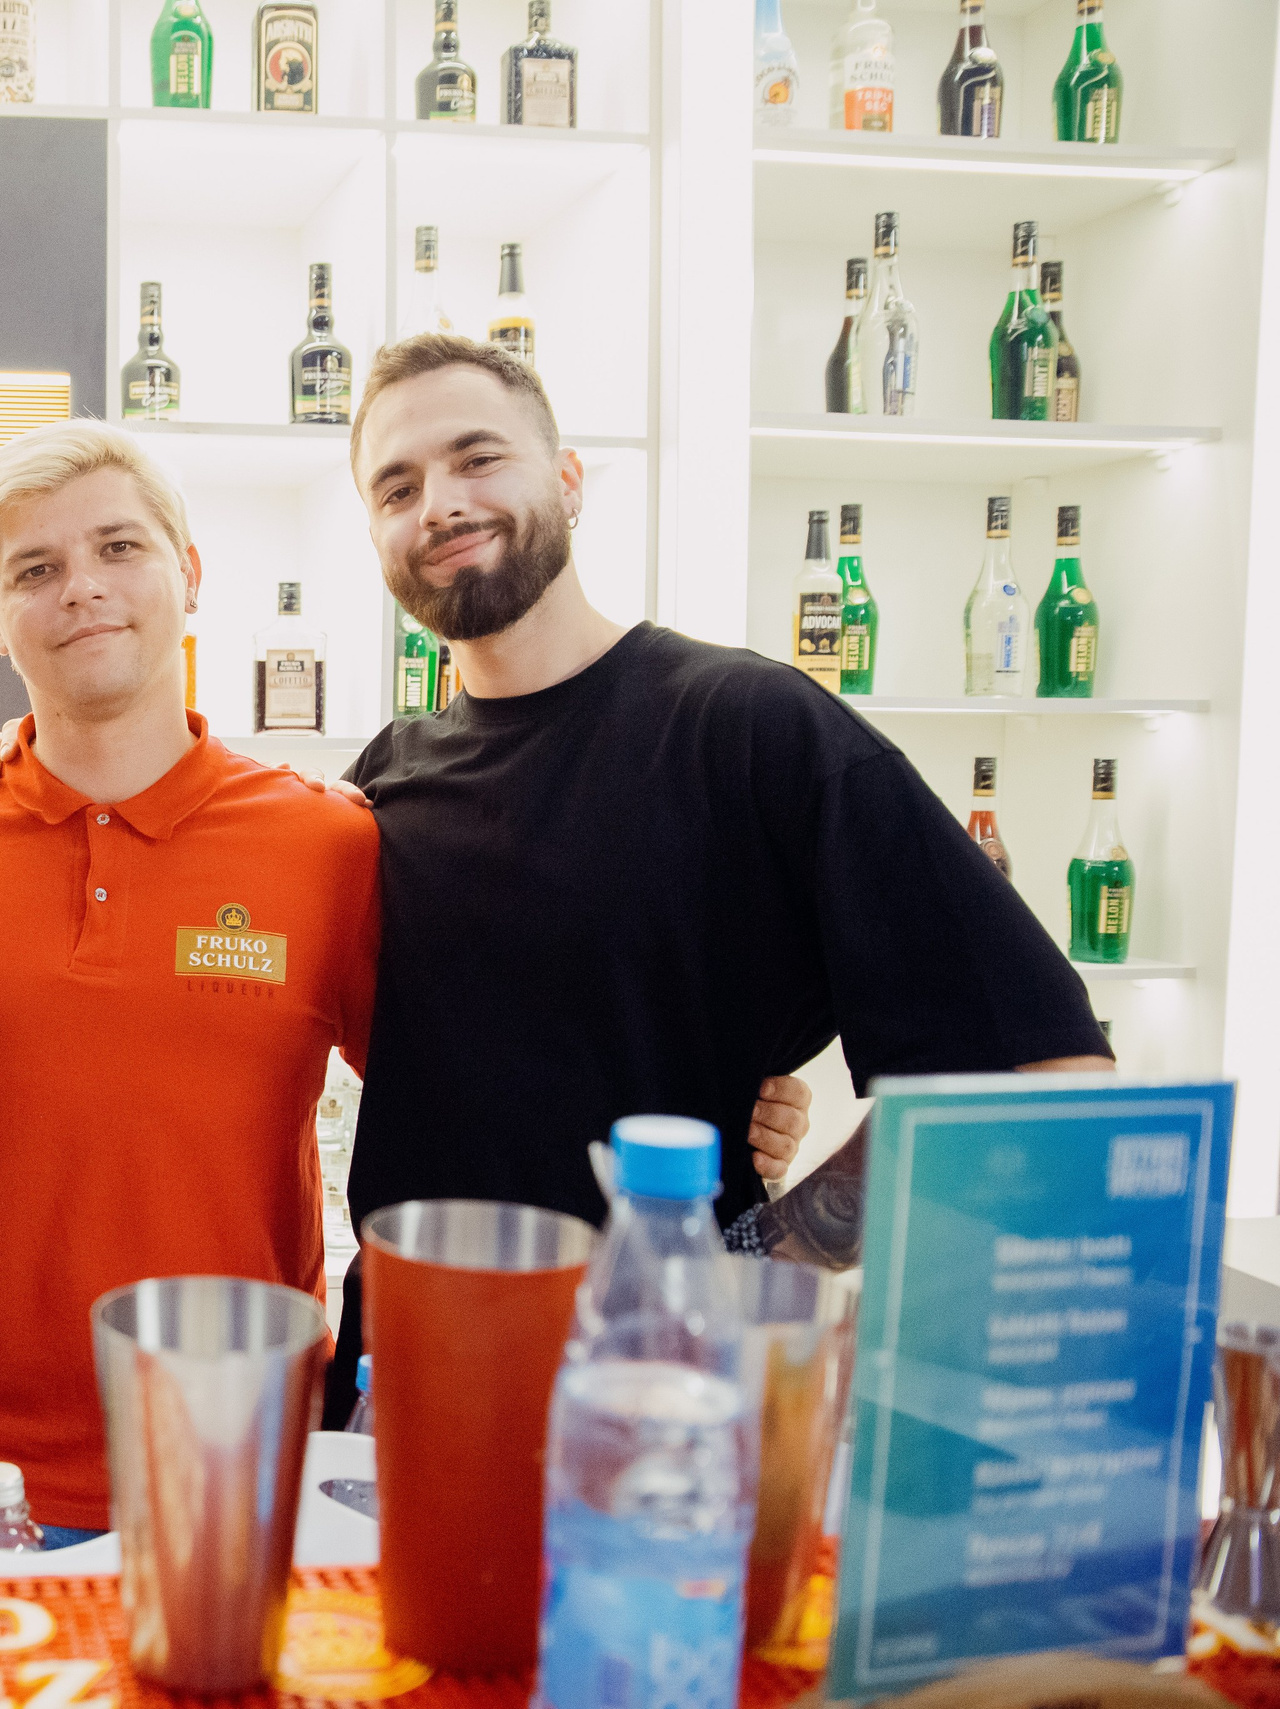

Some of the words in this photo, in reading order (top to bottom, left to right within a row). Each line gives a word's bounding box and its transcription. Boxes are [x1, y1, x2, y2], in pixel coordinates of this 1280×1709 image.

[848, 636, 859, 669] MELON
[1077, 637, 1088, 671] MELON
[406, 674, 421, 707] MINT
[1107, 899, 1119, 933] MELON
[196, 935, 267, 954] FRUKO
[188, 951, 273, 973] SCHULZ
[186, 980, 274, 998] LIQUEUR
